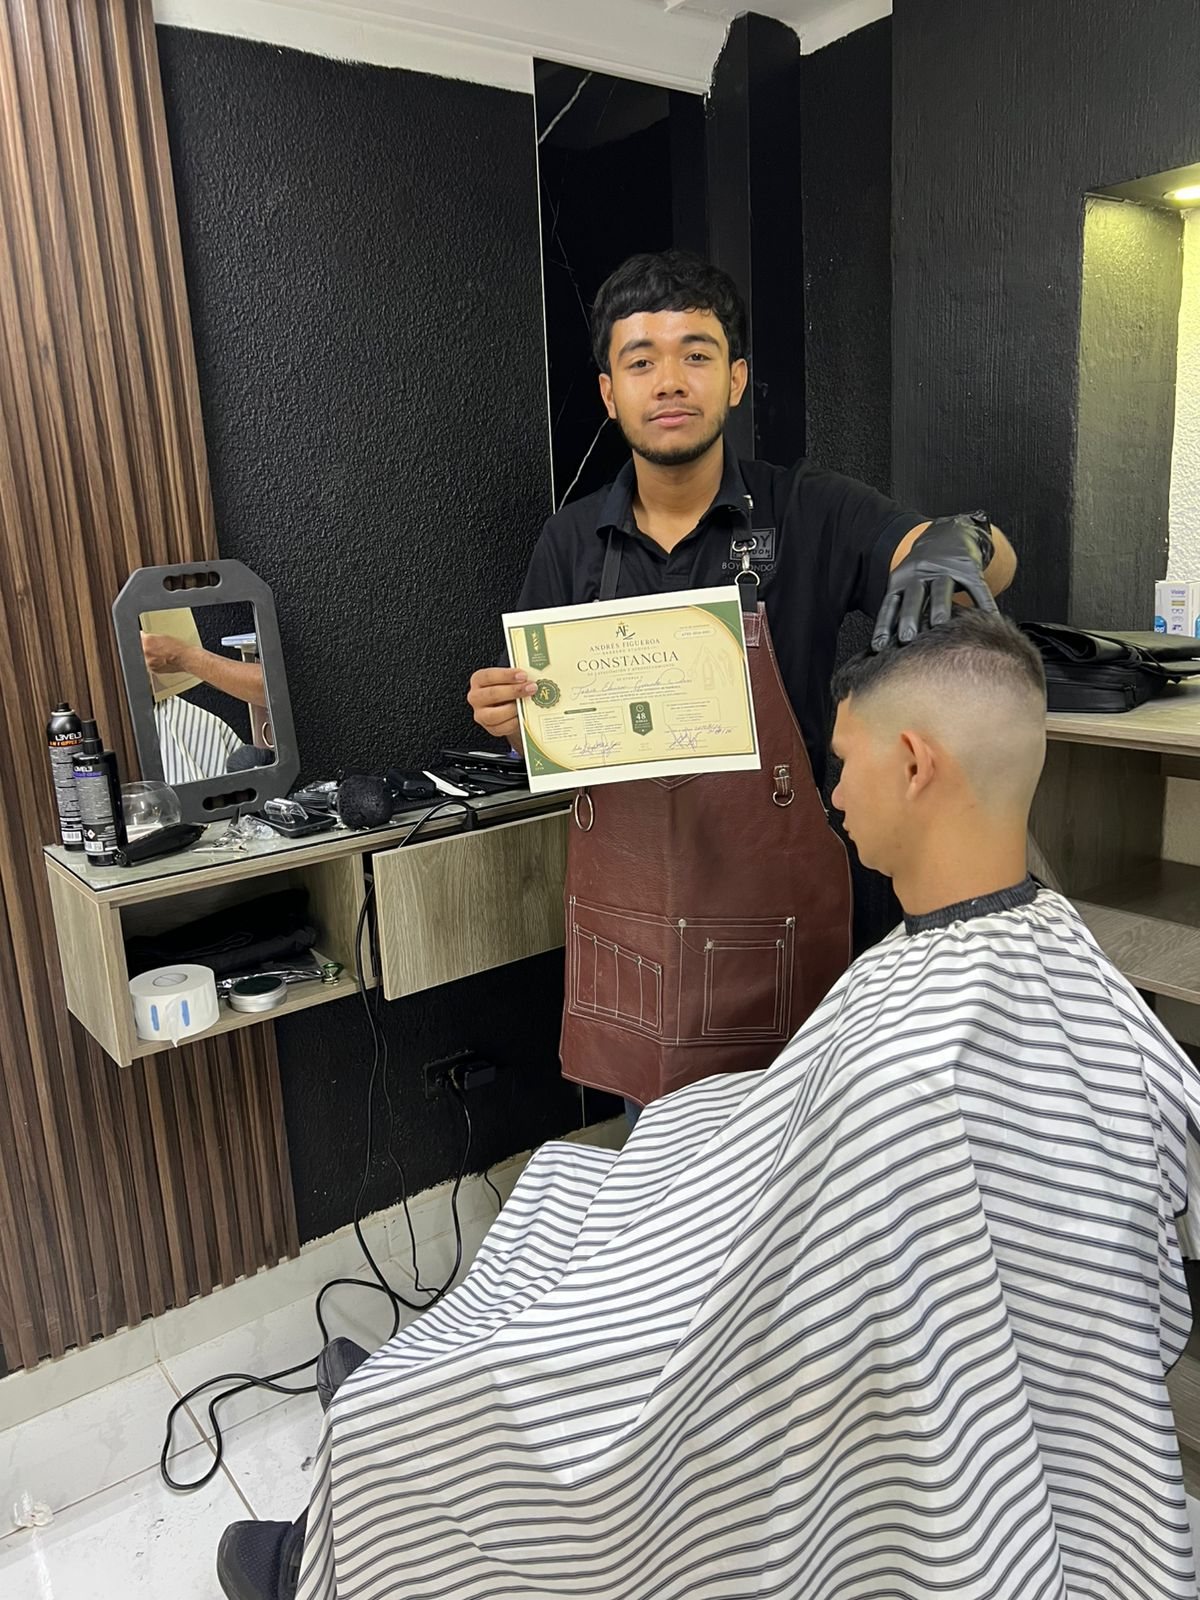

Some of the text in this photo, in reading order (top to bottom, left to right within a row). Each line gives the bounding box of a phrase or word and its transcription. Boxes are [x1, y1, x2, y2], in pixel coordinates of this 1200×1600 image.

[721, 561, 740, 571] BOY
[622, 639, 660, 648] FIGUEROA
[577, 651, 679, 673] CONSTANCIA
